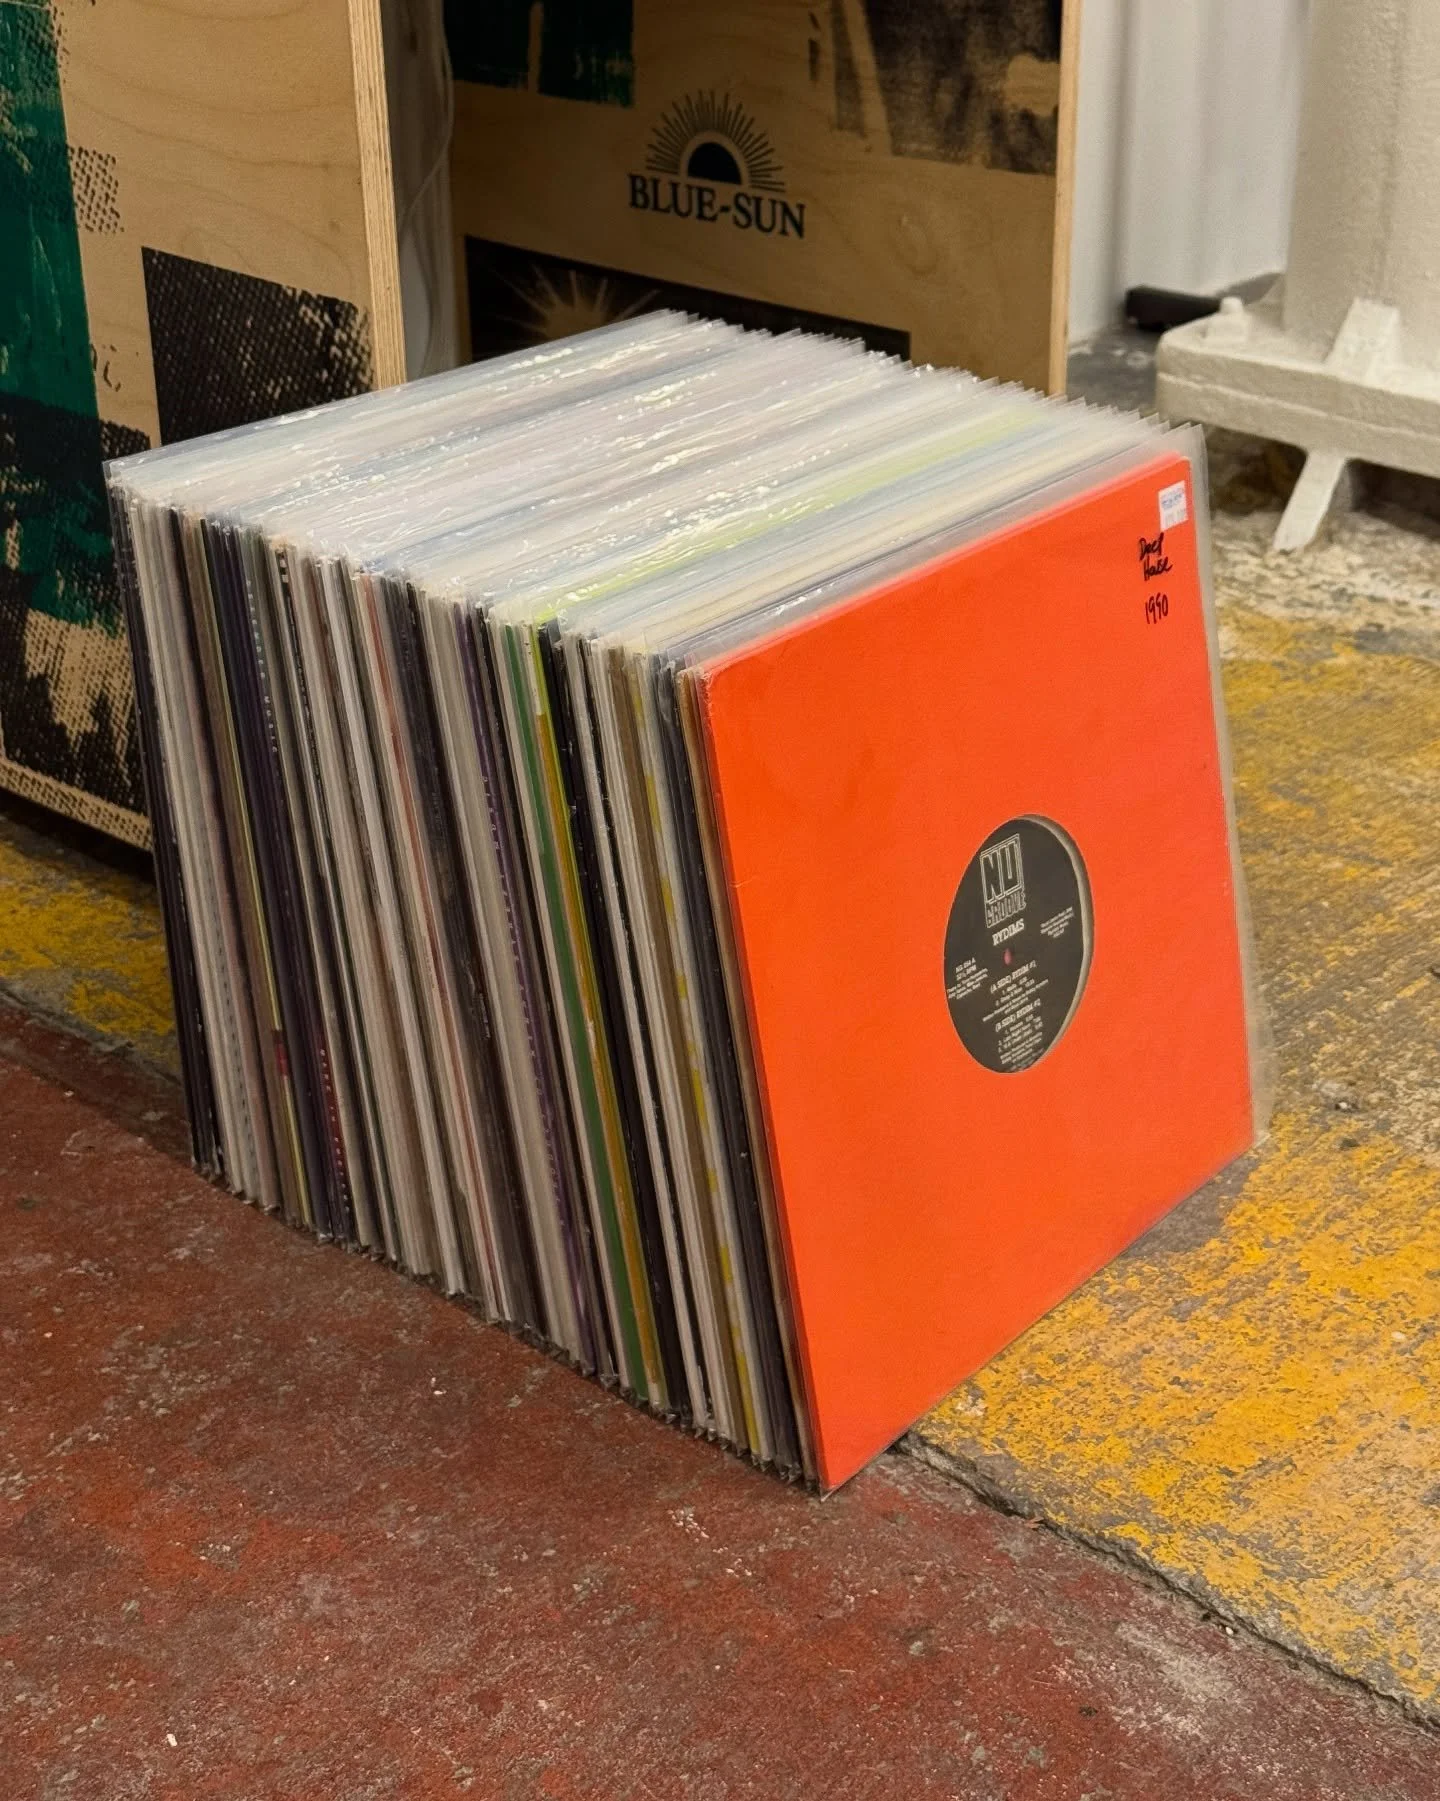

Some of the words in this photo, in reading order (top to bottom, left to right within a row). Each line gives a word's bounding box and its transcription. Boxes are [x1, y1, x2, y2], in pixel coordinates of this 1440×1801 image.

[628, 173, 806, 238] BLUE-SUN
[1145, 592, 1169, 625] 1990
[981, 837, 1022, 904] NU
[985, 890, 1027, 928] GROOVE
[992, 918, 1025, 946] RYDIMS
